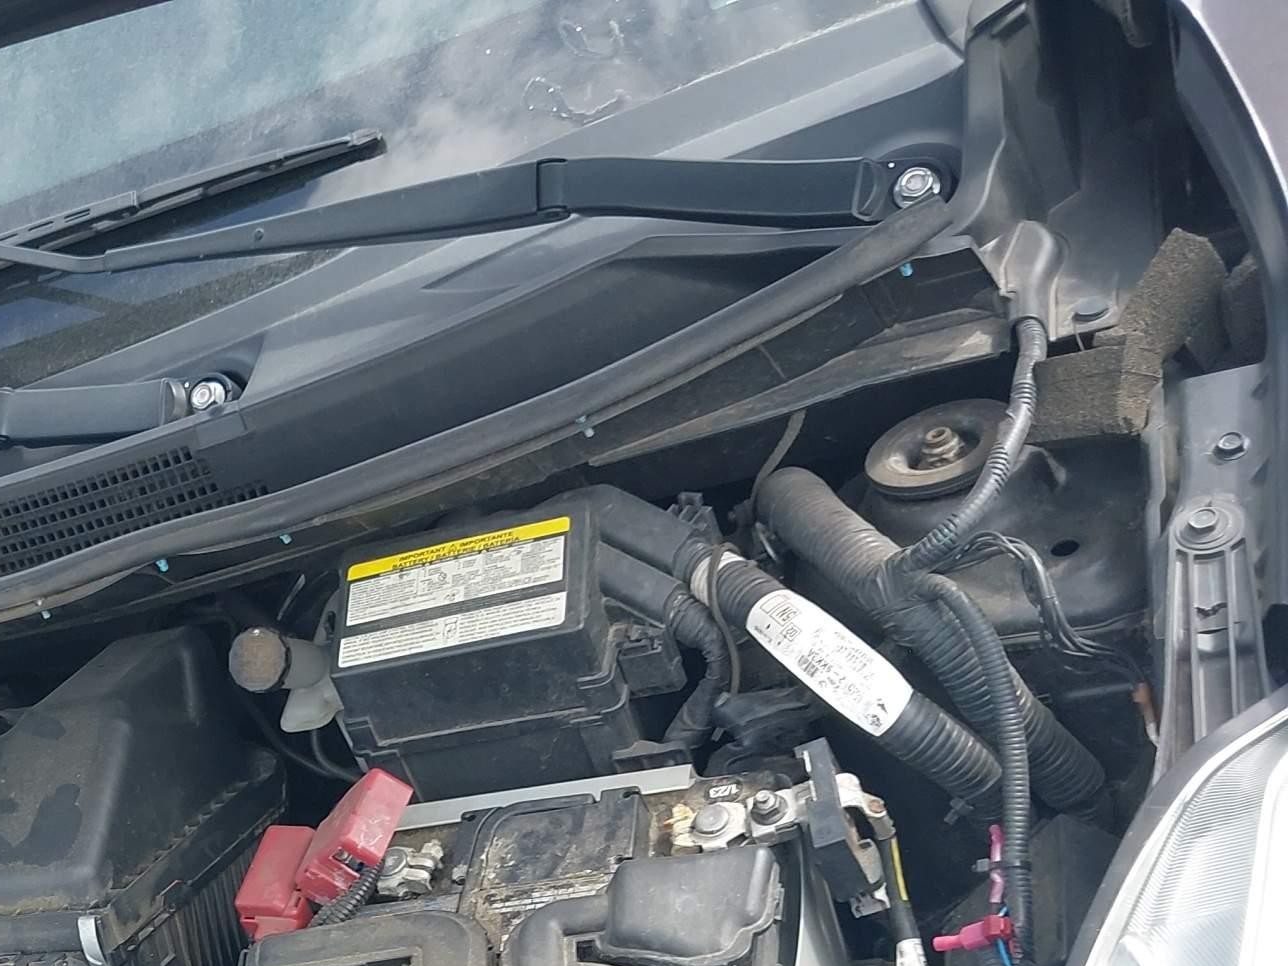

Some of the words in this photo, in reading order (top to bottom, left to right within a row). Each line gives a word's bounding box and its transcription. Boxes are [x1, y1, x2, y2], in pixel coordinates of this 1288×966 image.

[399, 547, 447, 561] IMPORTANT
[460, 532, 512, 547] IMPORTANTE
[393, 557, 428, 568] BATTERY
